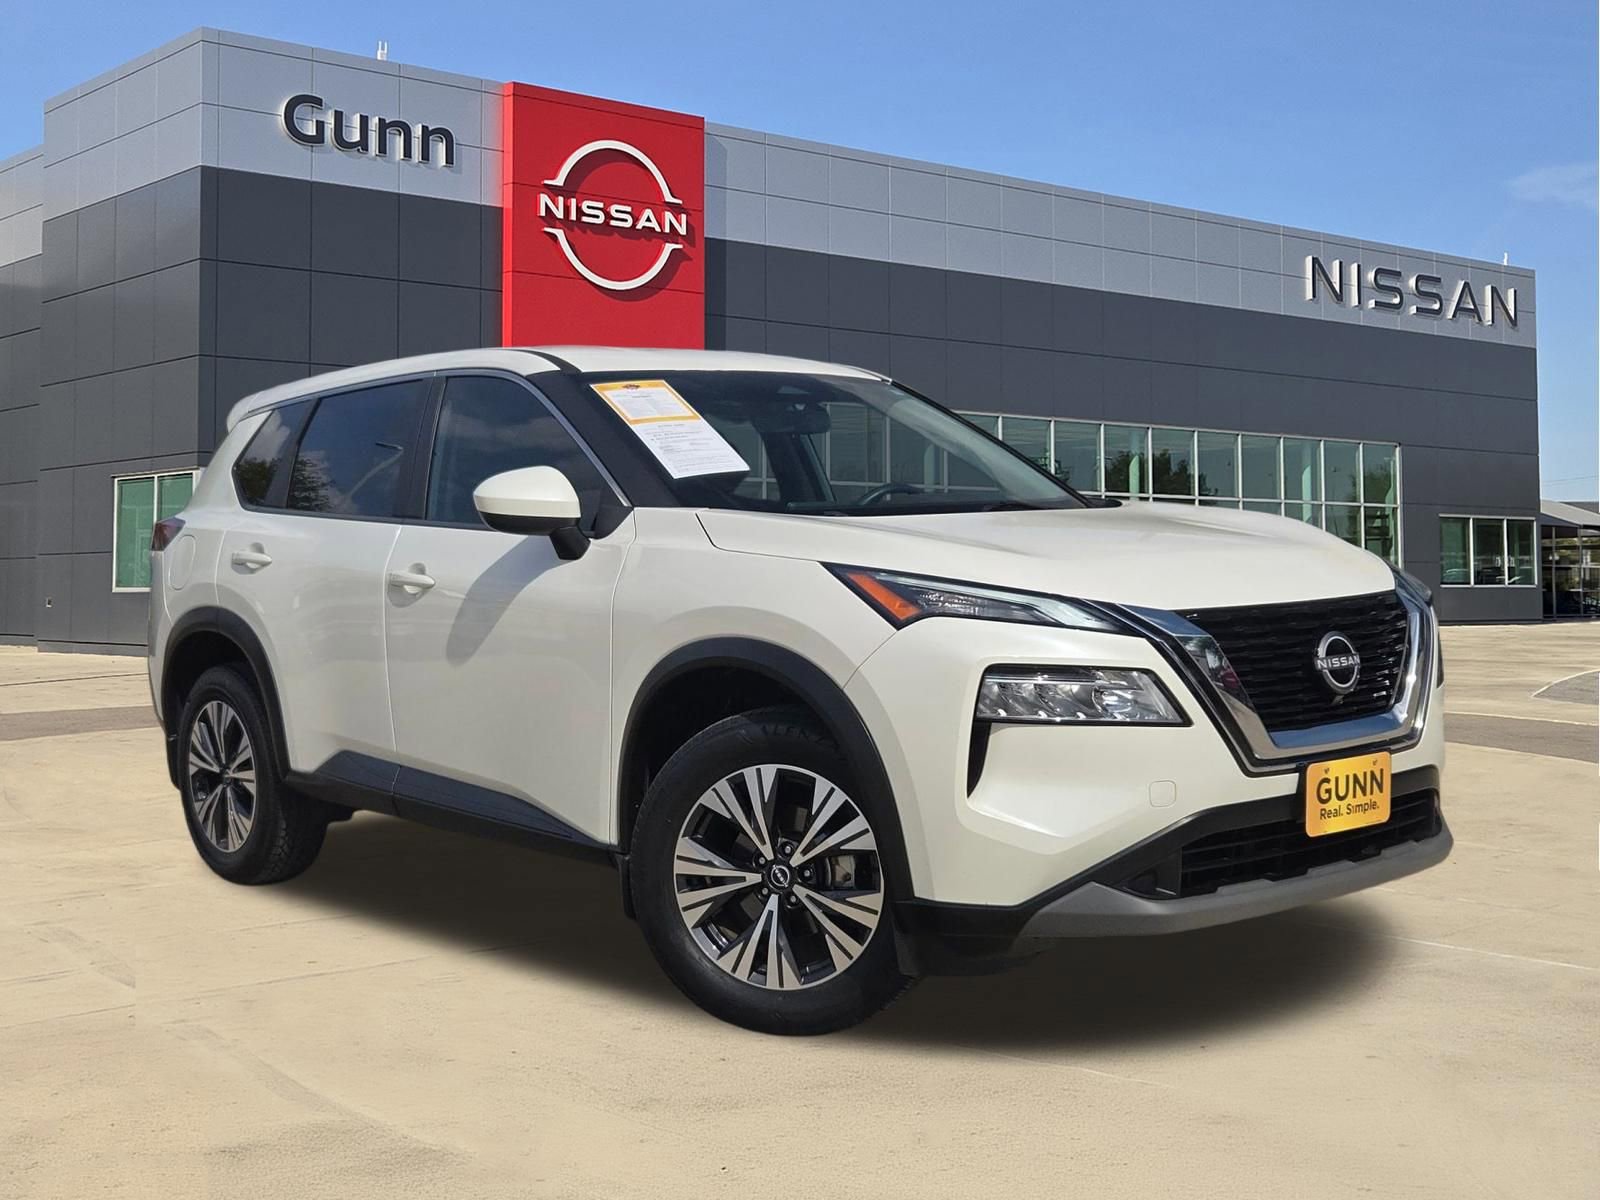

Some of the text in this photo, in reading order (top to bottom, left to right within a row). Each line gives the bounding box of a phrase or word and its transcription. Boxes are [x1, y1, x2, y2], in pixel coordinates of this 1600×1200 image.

[282, 93, 456, 168] Gunn
[538, 192, 688, 236] NISSAN
[1305, 255, 1519, 328] NISSAN
[1316, 654, 1361, 670] NISSAN
[1316, 768, 1384, 805] GUNN
[1320, 798, 1380, 820] Real. Simple.
